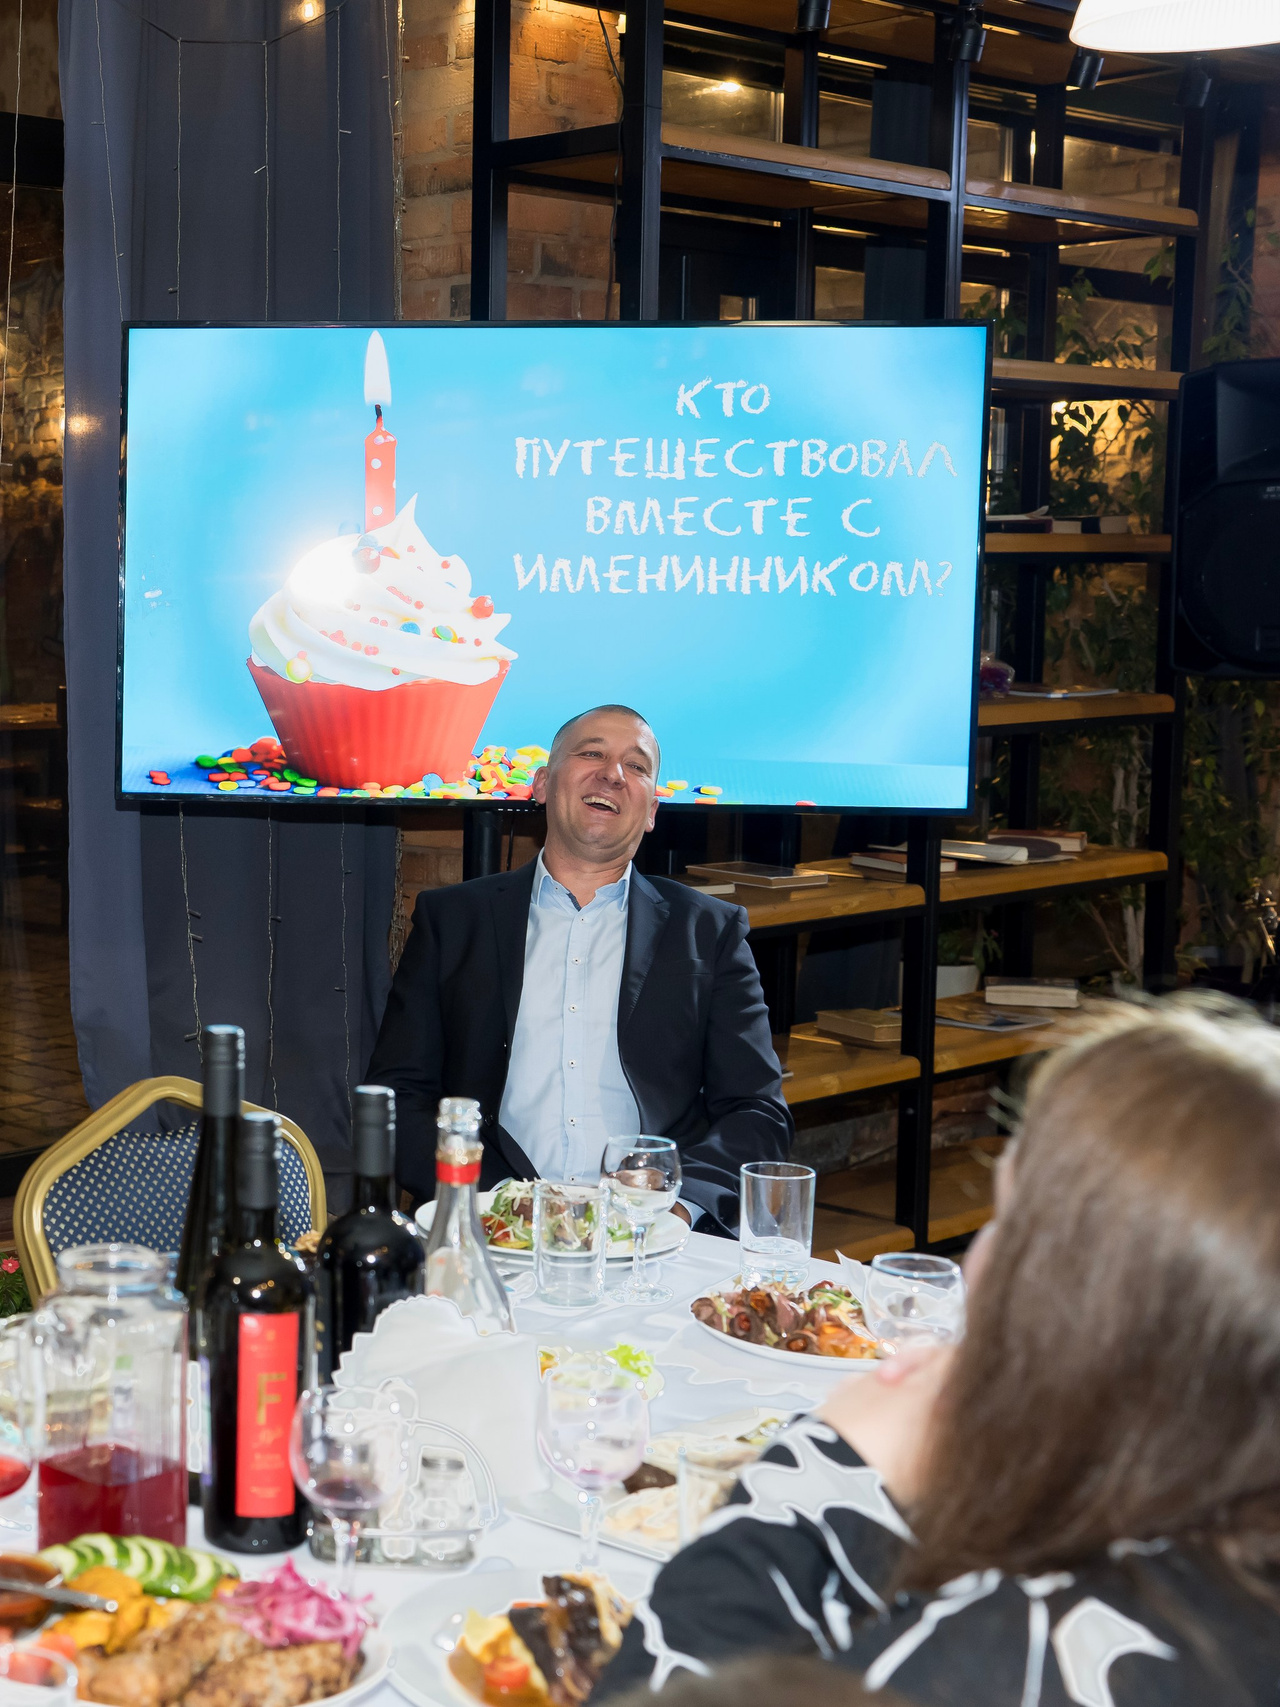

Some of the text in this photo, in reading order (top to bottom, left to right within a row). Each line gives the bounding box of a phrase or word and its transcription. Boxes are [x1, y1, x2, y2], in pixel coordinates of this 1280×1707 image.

[675, 375, 772, 419] КТО
[514, 436, 959, 480] ПУТЕШЕСТВОВАЛ
[585, 495, 881, 538] ВМЕСТЕ С
[512, 552, 954, 597] ИМЕНИННИКОМ?
[256, 1372, 288, 1426] F
